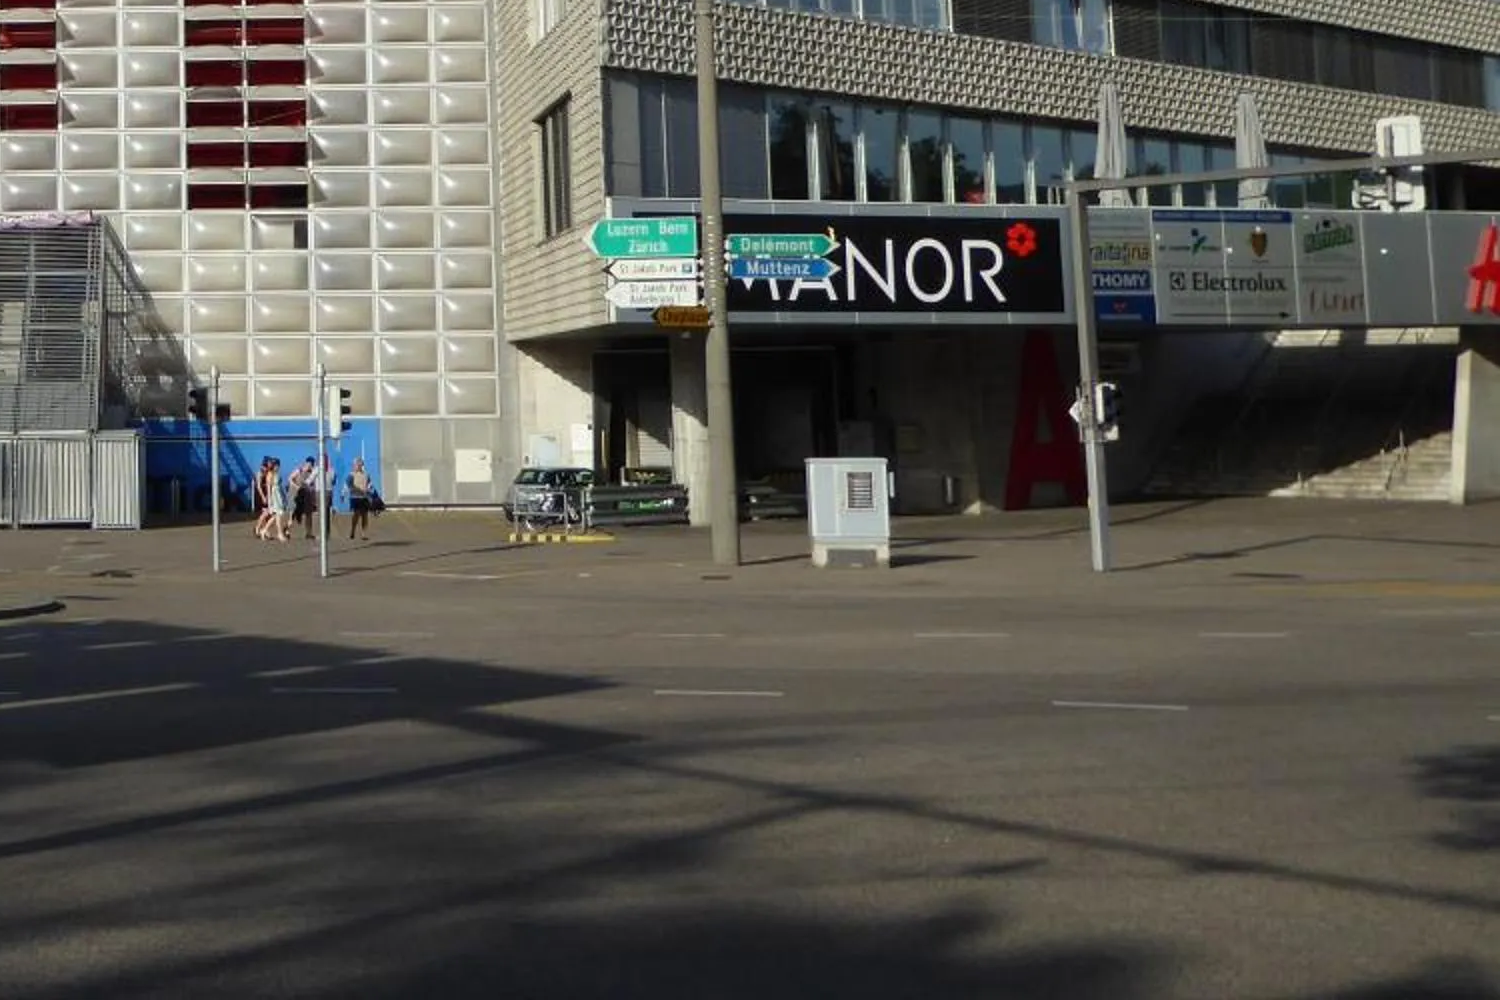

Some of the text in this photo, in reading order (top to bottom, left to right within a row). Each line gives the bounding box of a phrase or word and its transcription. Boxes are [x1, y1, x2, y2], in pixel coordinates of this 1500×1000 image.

[607, 219, 689, 237] Luzern Bern
[740, 237, 814, 253] Delémont
[746, 260, 812, 276] Muttenz
[1092, 272, 1148, 288] THOMY
[1192, 271, 1287, 292] Electrolux
[1004, 328, 1088, 511] A
